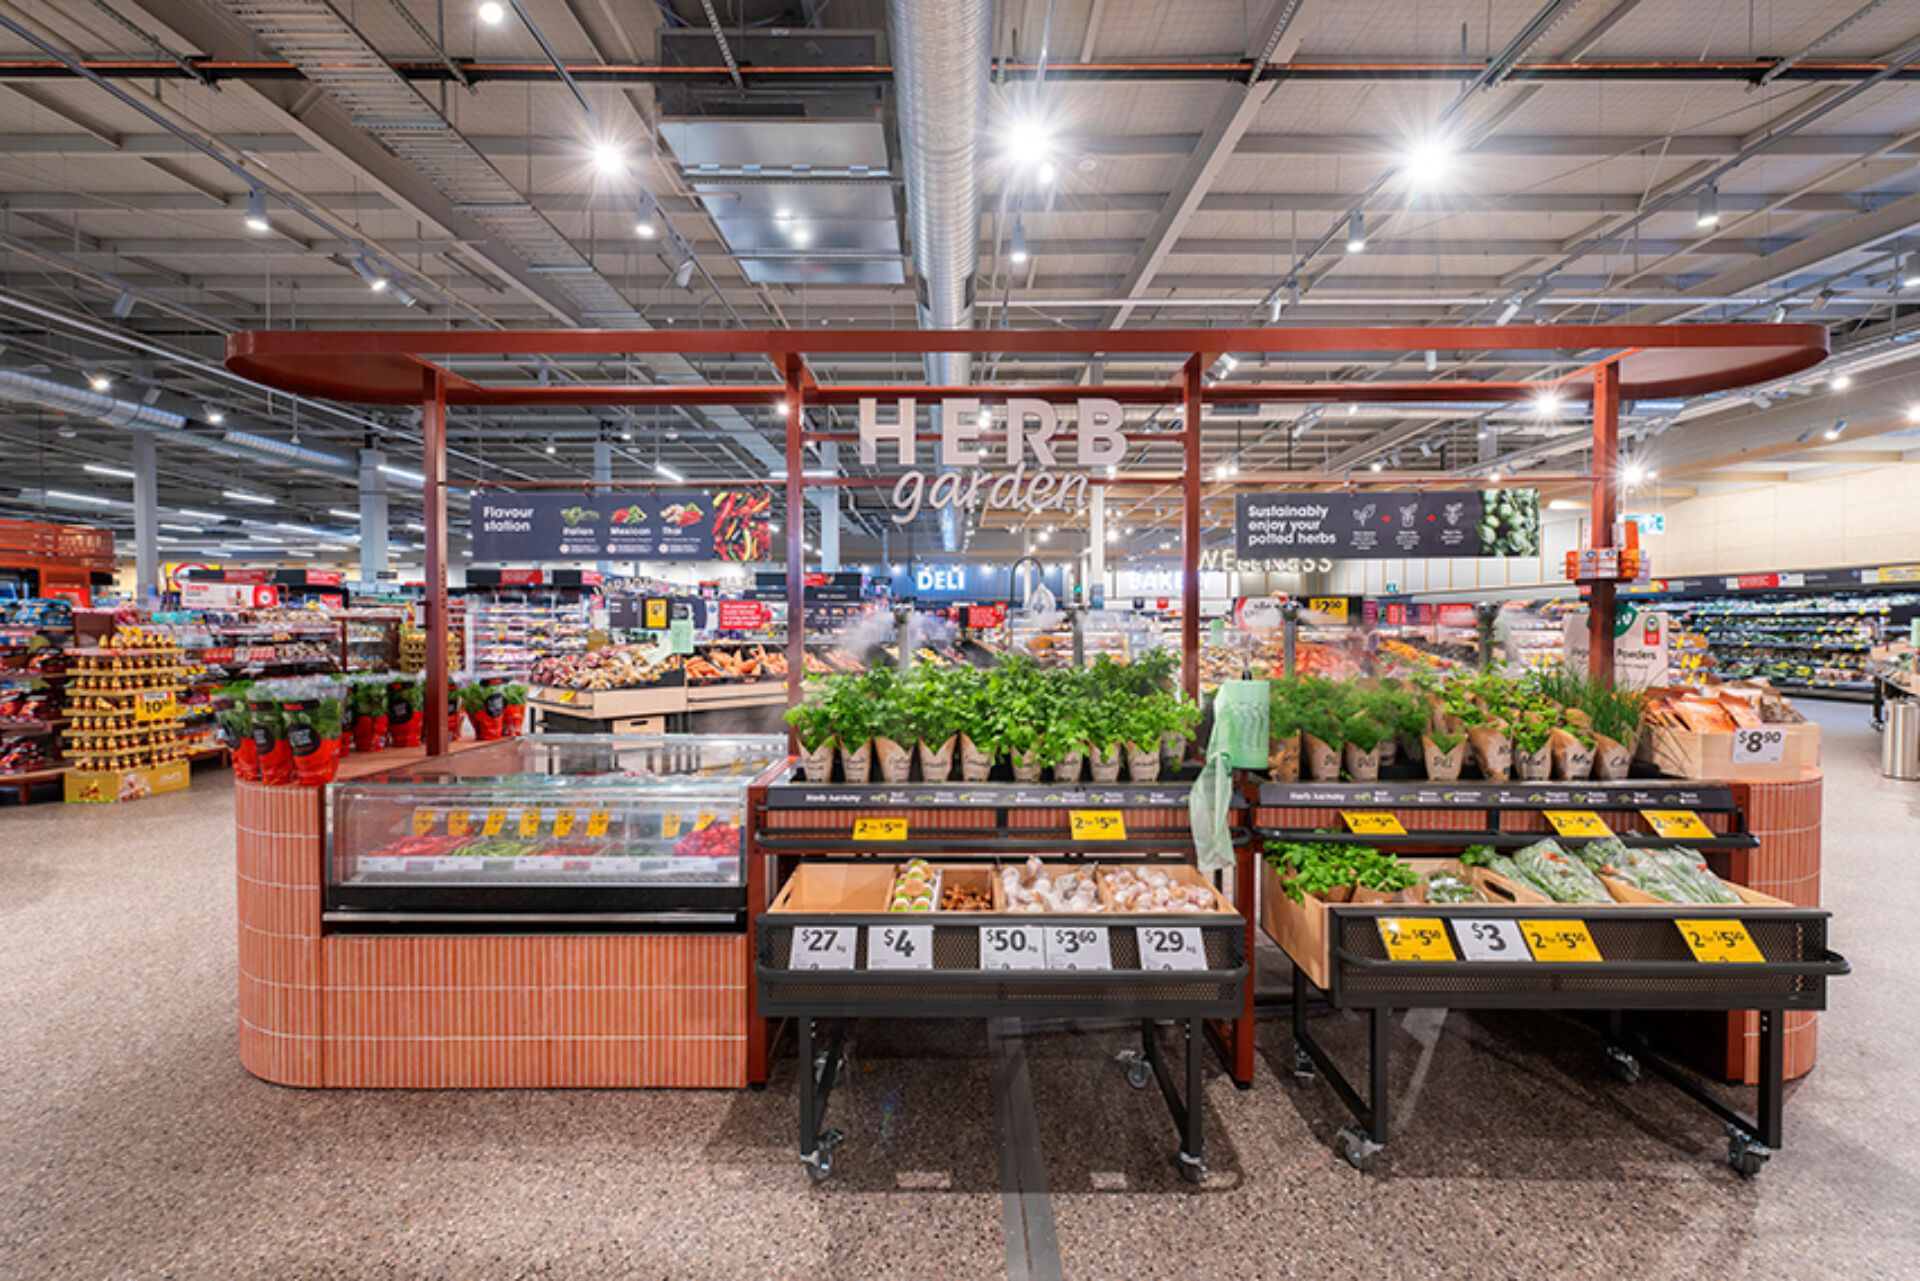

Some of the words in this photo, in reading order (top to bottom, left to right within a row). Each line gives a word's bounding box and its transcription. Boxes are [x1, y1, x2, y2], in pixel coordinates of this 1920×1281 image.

[859, 398, 1127, 466] HERB
[891, 461, 1089, 525] garden
[483, 506, 534, 518] Flavour
[1248, 504, 1329, 519] Sustainably
[483, 520, 531, 532] station
[661, 526, 682, 535] Thai
[1248, 520, 1287, 533] enjoy
[1289, 521, 1321, 533] your
[1248, 532, 1294, 547] potted
[1298, 532, 1336, 545] herbs
[917, 571, 965, 590] DELI
[857, 822, 868, 833] 2
[1074, 817, 1084, 829] 2
[1350, 816, 1361, 827] 2
[1553, 817, 1567, 829] 2
[1651, 817, 1665, 829] 2
[802, 929, 839, 951] $27
[883, 928, 916, 957] $4
[986, 929, 1027, 952] $50
[1144, 930, 1185, 953] $29
[1387, 929, 1401, 946] 2
[1471, 922, 1507, 951] $3
[1530, 932, 1547, 949] 2
[1688, 931, 1706, 948] 2
